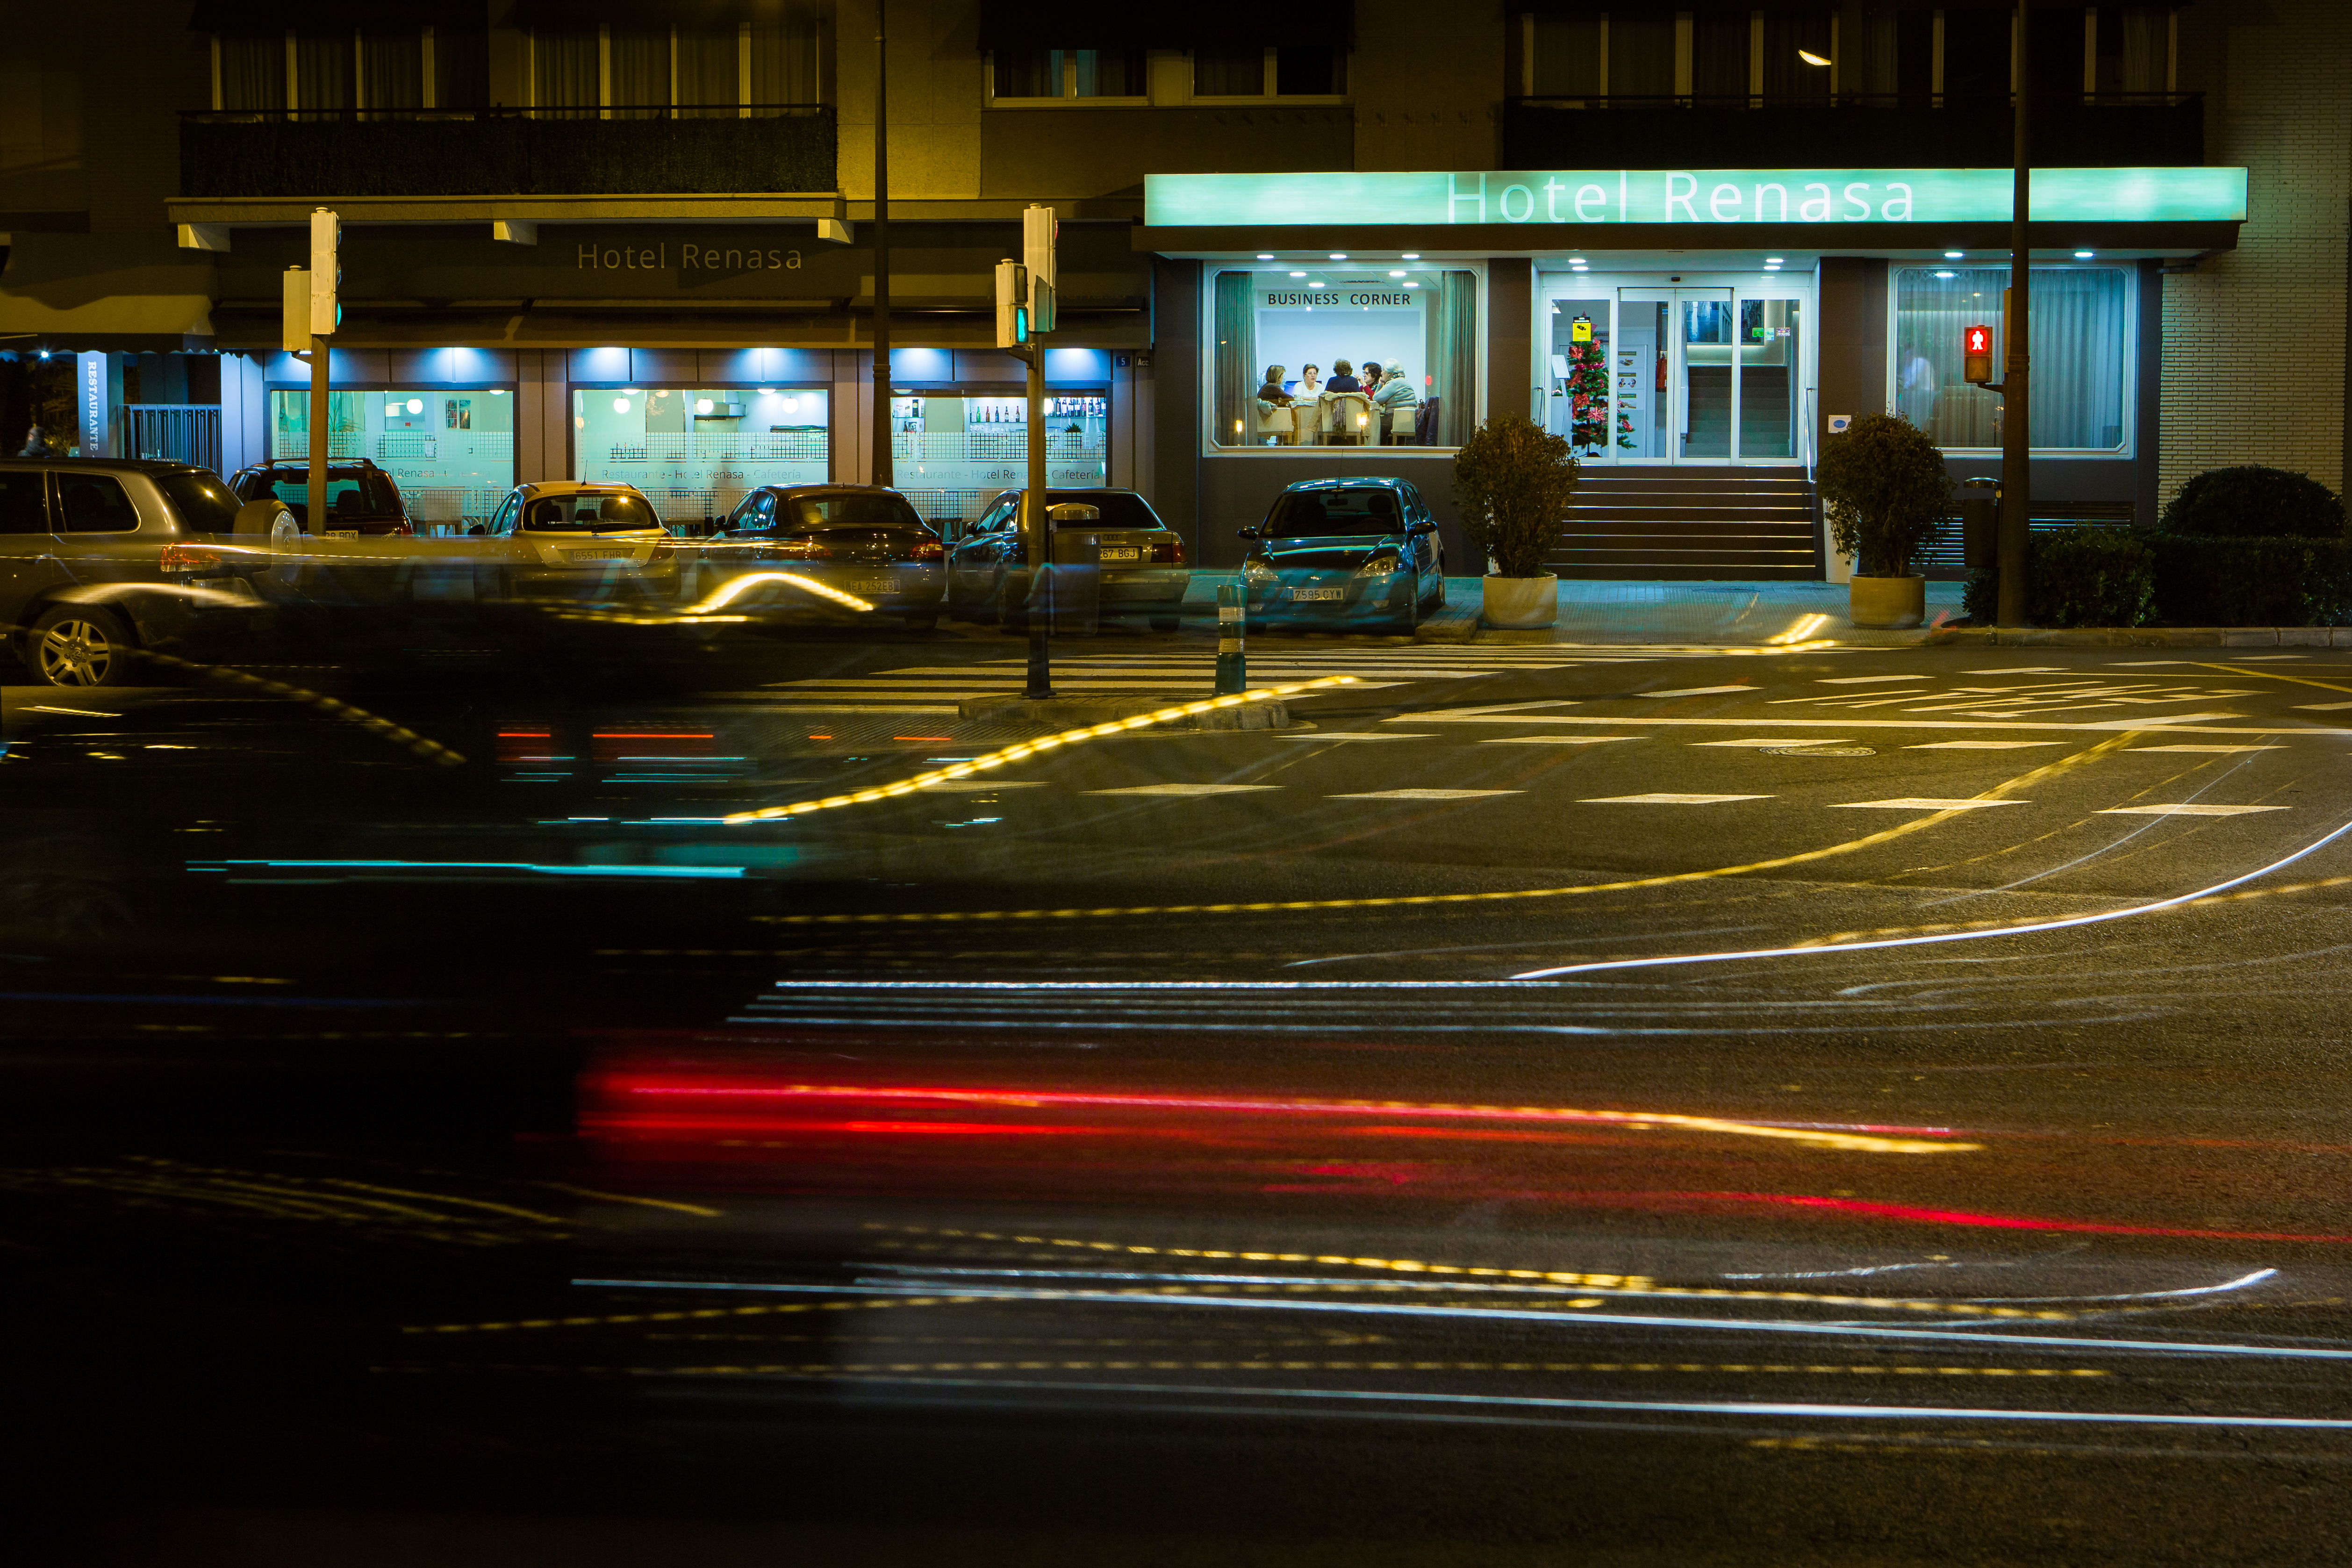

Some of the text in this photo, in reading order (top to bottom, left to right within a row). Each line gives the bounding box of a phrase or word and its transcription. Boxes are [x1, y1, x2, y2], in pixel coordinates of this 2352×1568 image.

[1448, 170, 1913, 223] Hotel Renasa
[578, 243, 802, 269] Hotel Renasa
[1268, 294, 1411, 306] BUSINESS CORNER
[87, 361, 99, 451] RESTAURANTE
[398, 468, 435, 478] Renasa
[602, 469, 665, 479] Restaurante
[706, 469, 744, 479] Renasa
[754, 469, 801, 479] Cafetería
[897, 469, 961, 479] Restaurante
[971, 469, 999, 479] Hotel
[1003, 469, 1028, 479] Rena
[1052, 469, 1100, 480] Cafetería
[575, 551, 622, 560] 6551 FHR
[1118, 549, 1135, 558] BGJ
[852, 582, 893, 591] EA 252EB
[1295, 590, 1341, 599] 7595 CYW
[1764, 689, 2126, 718] TAXI
